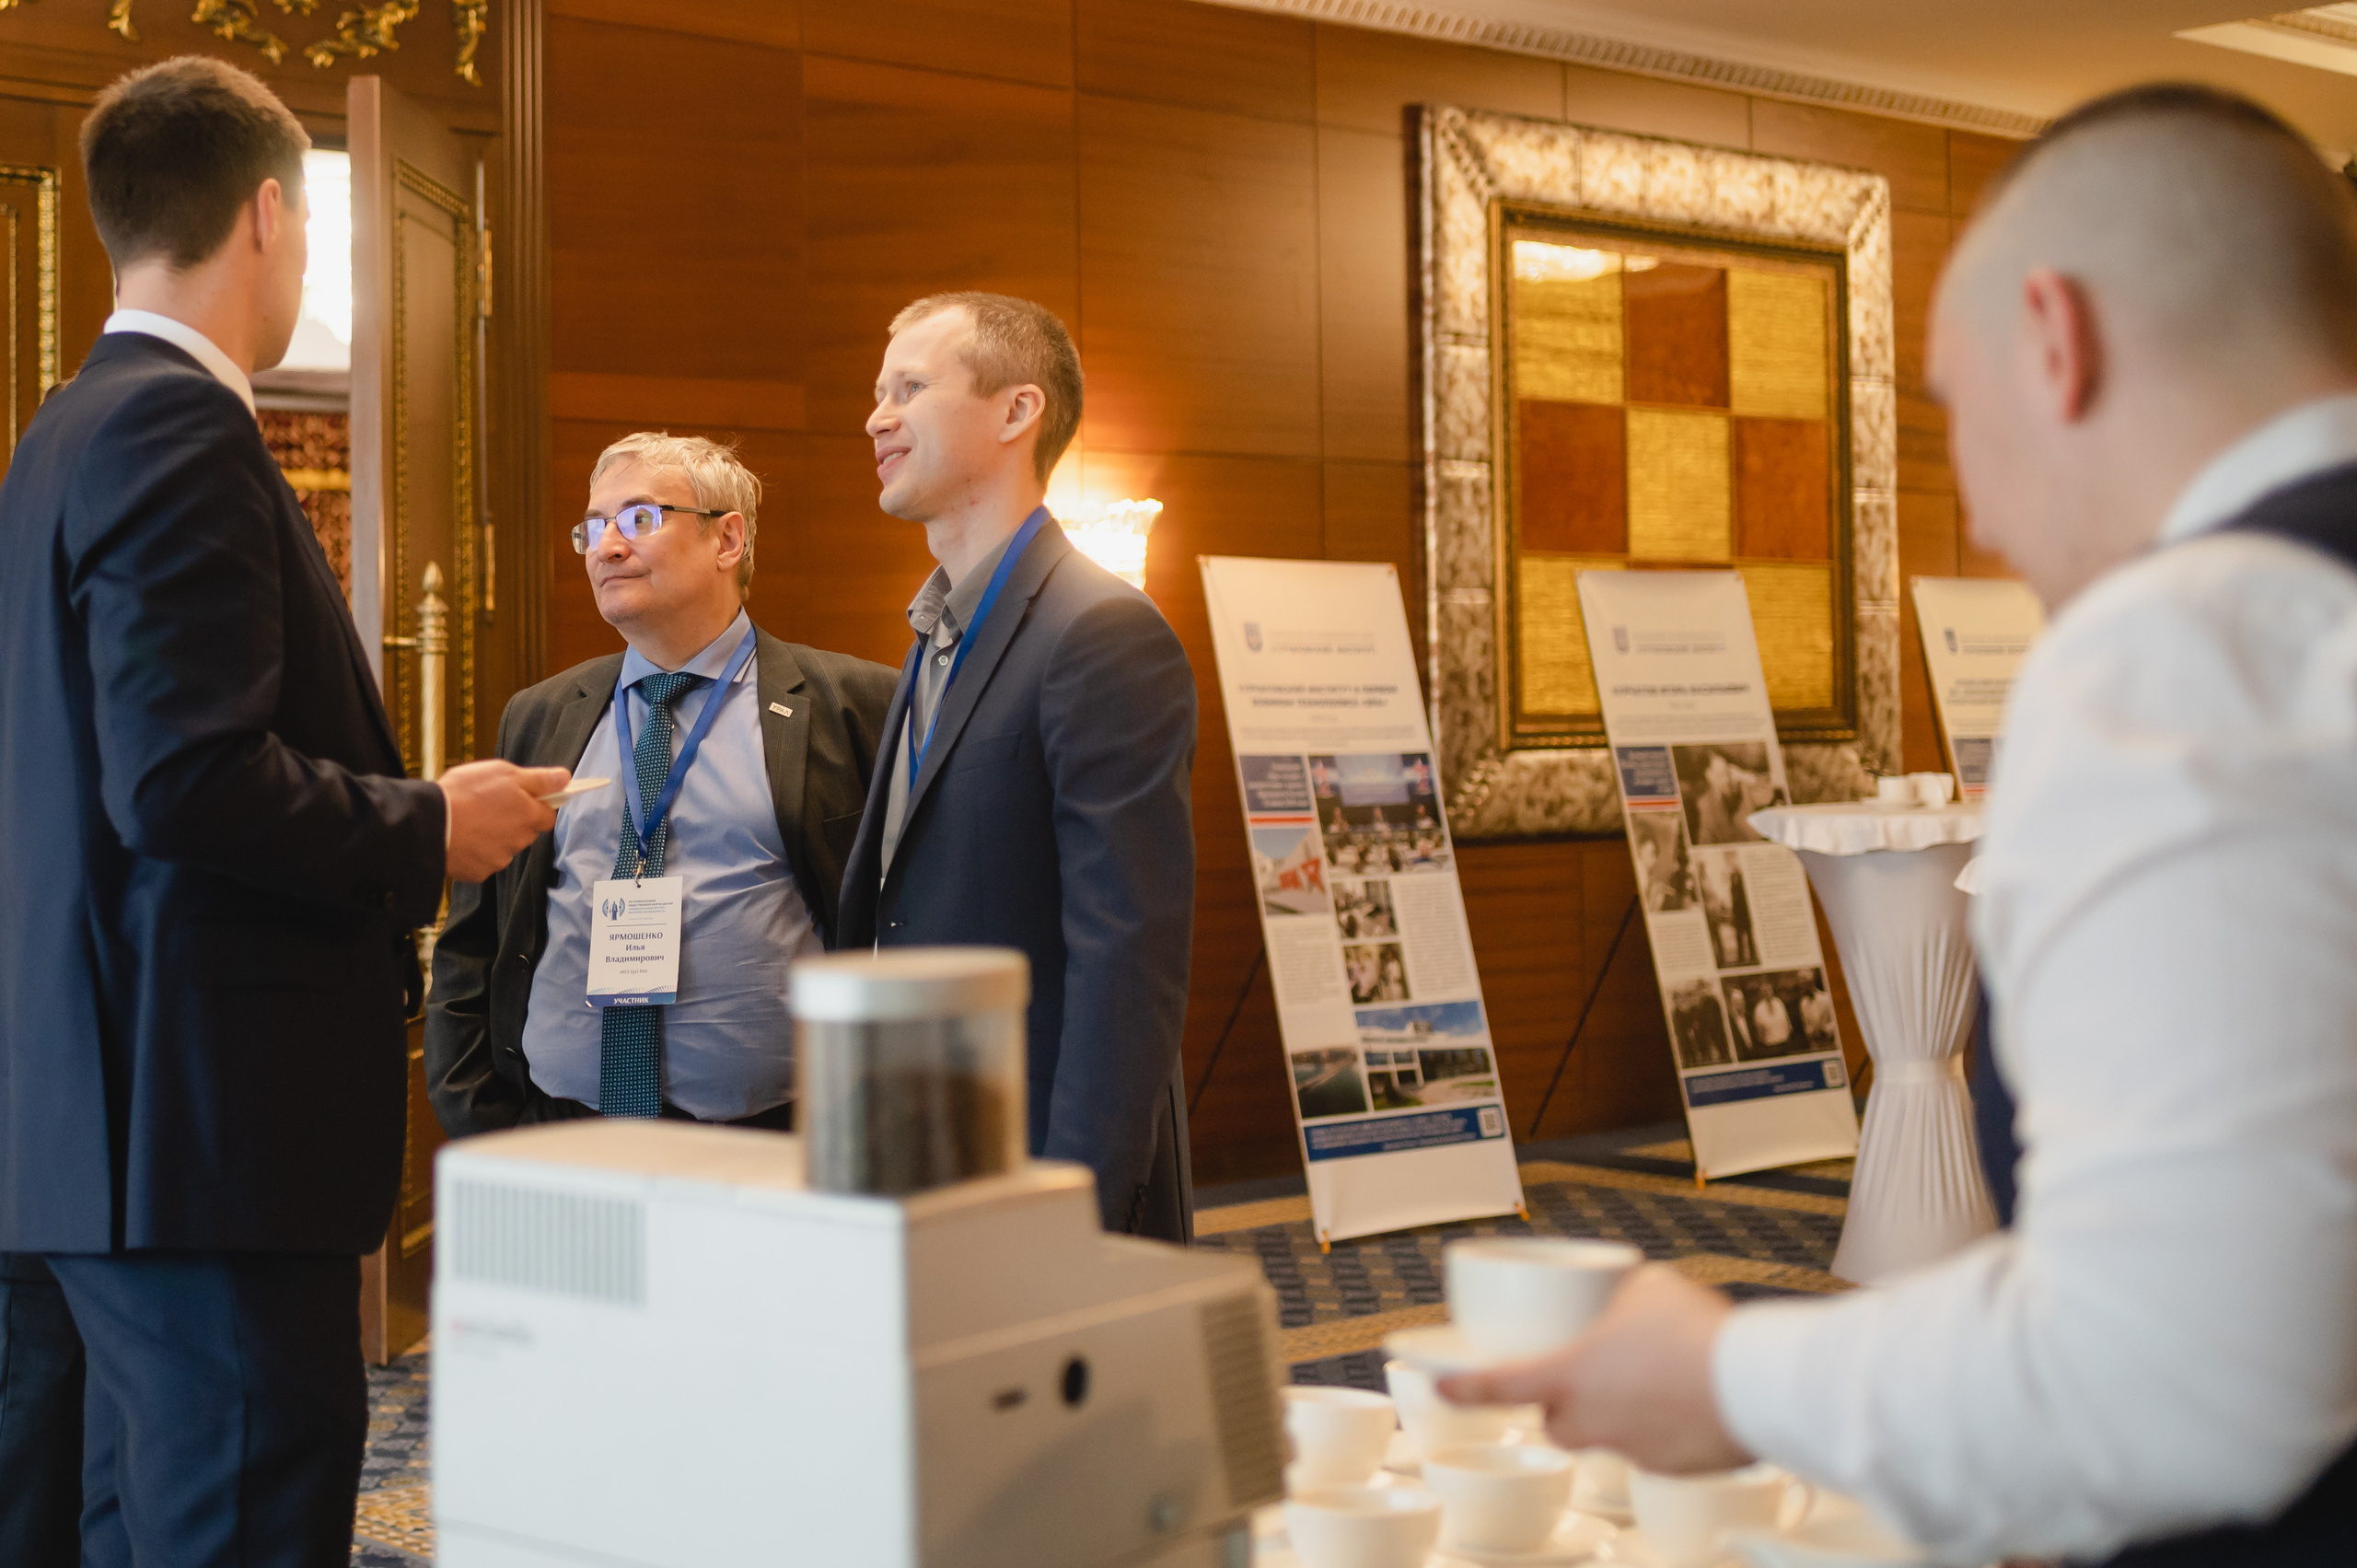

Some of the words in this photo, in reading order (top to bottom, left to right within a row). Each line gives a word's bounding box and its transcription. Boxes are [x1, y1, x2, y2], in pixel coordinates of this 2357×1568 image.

[772, 704, 789, 715] УРАЛ
[609, 932, 664, 941] ЯРМОШЕНКО
[605, 955, 665, 964] Владимирович
